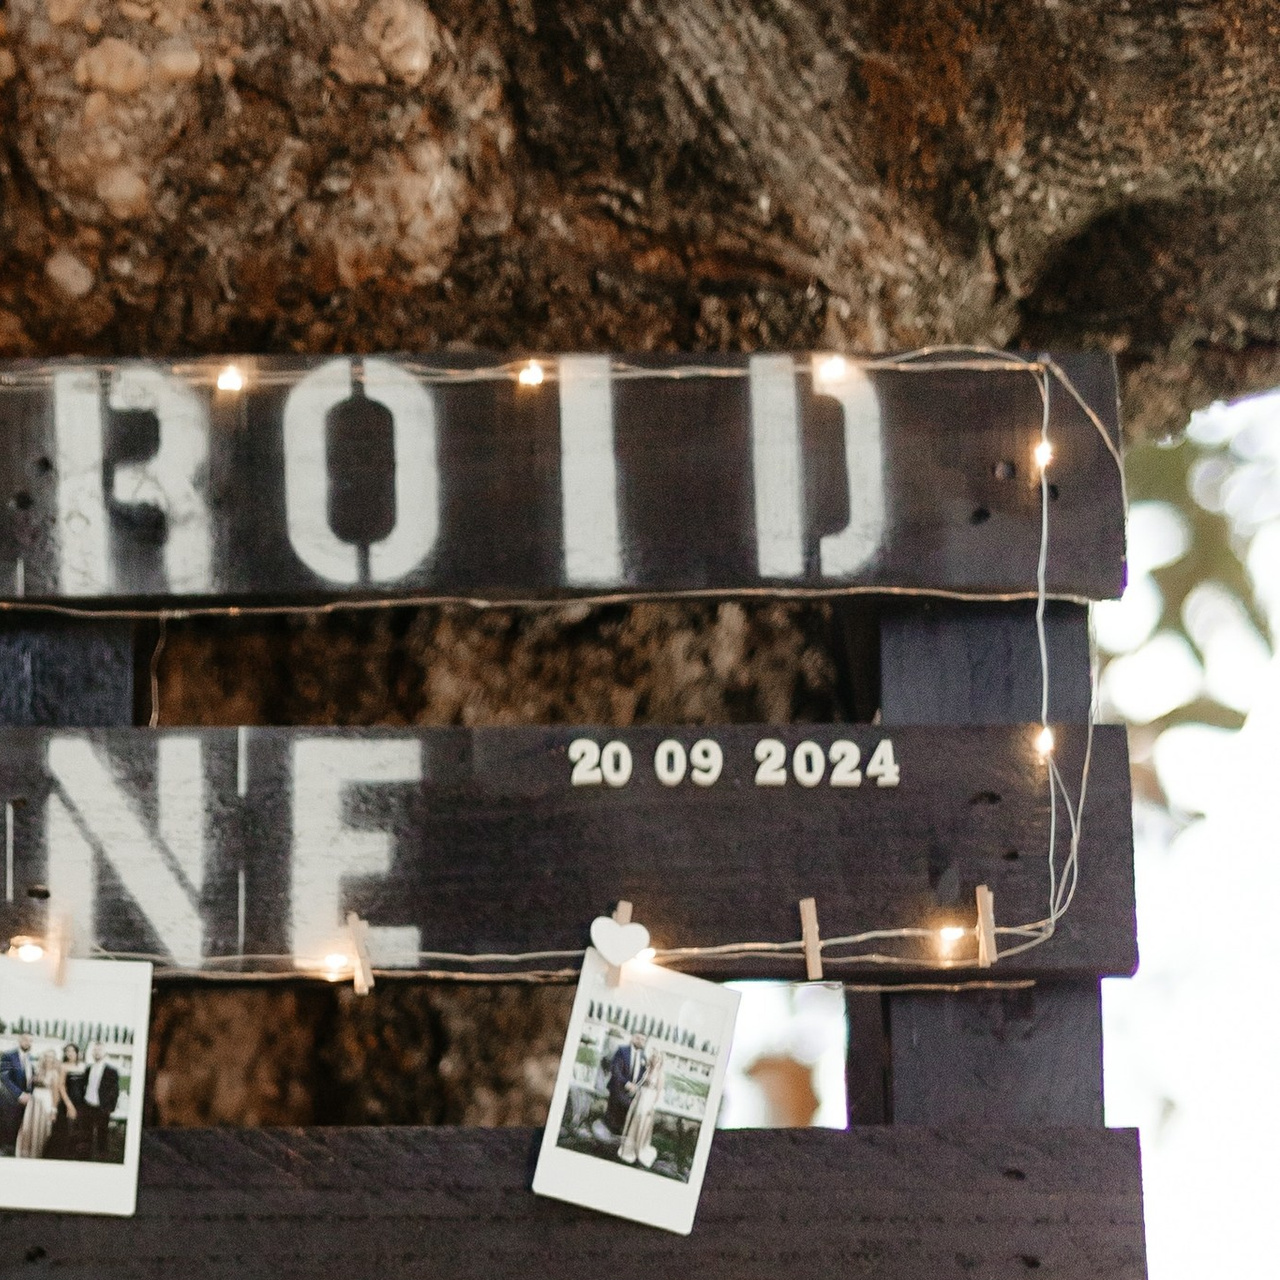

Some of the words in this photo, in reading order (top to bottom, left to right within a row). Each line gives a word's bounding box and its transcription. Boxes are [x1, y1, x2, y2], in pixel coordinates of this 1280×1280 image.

[568, 738, 633, 788] 20
[654, 738, 724, 788] 09
[754, 738, 901, 788] 2024
